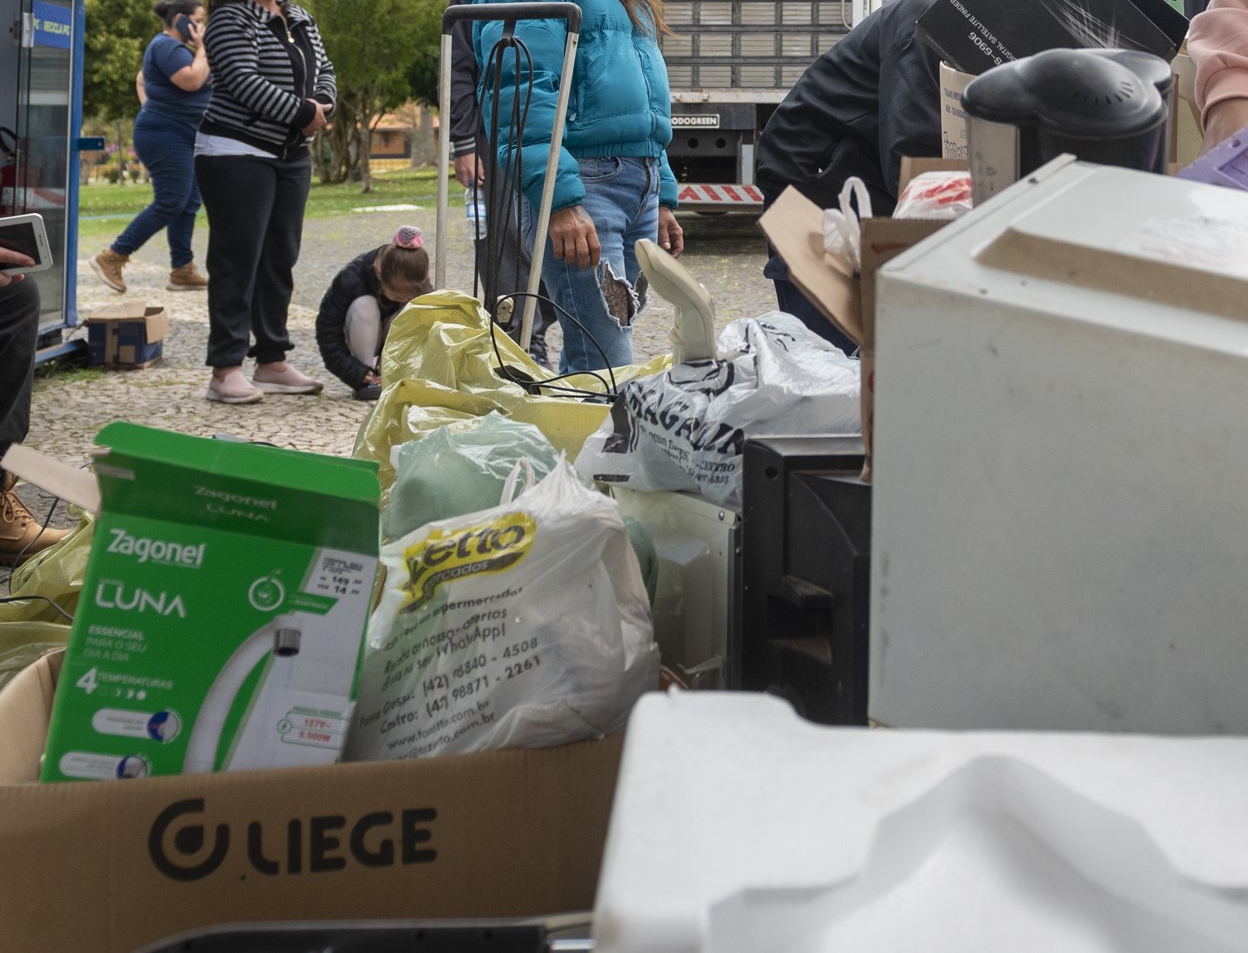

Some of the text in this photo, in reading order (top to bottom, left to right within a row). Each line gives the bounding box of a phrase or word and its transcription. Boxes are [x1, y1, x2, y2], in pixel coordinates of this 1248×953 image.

[968, 16, 997, 44] SATELLITE
[968, 32, 1002, 65] S-6906
[670, 116, 717, 126] ODOGREEN
[193, 485, 277, 510] Zagonel
[206, 503, 269, 523] LUNA
[107, 528, 208, 566] Zagonel
[95, 582, 186, 619] LUNA
[86, 637, 112, 647] PARA
[125, 643, 147, 652] SEU
[88, 625, 145, 641] ESSENCIAL
[83, 649, 129, 661] DIA A DIA
[423, 674, 449, 697] (42)
[503, 638, 538, 659] 4508
[76, 667, 174, 694] 4 TEMPERATURAS
[452, 676, 489, 702] 98871
[505, 655, 541, 680] 2261
[248, 808, 437, 875] LIEGE
